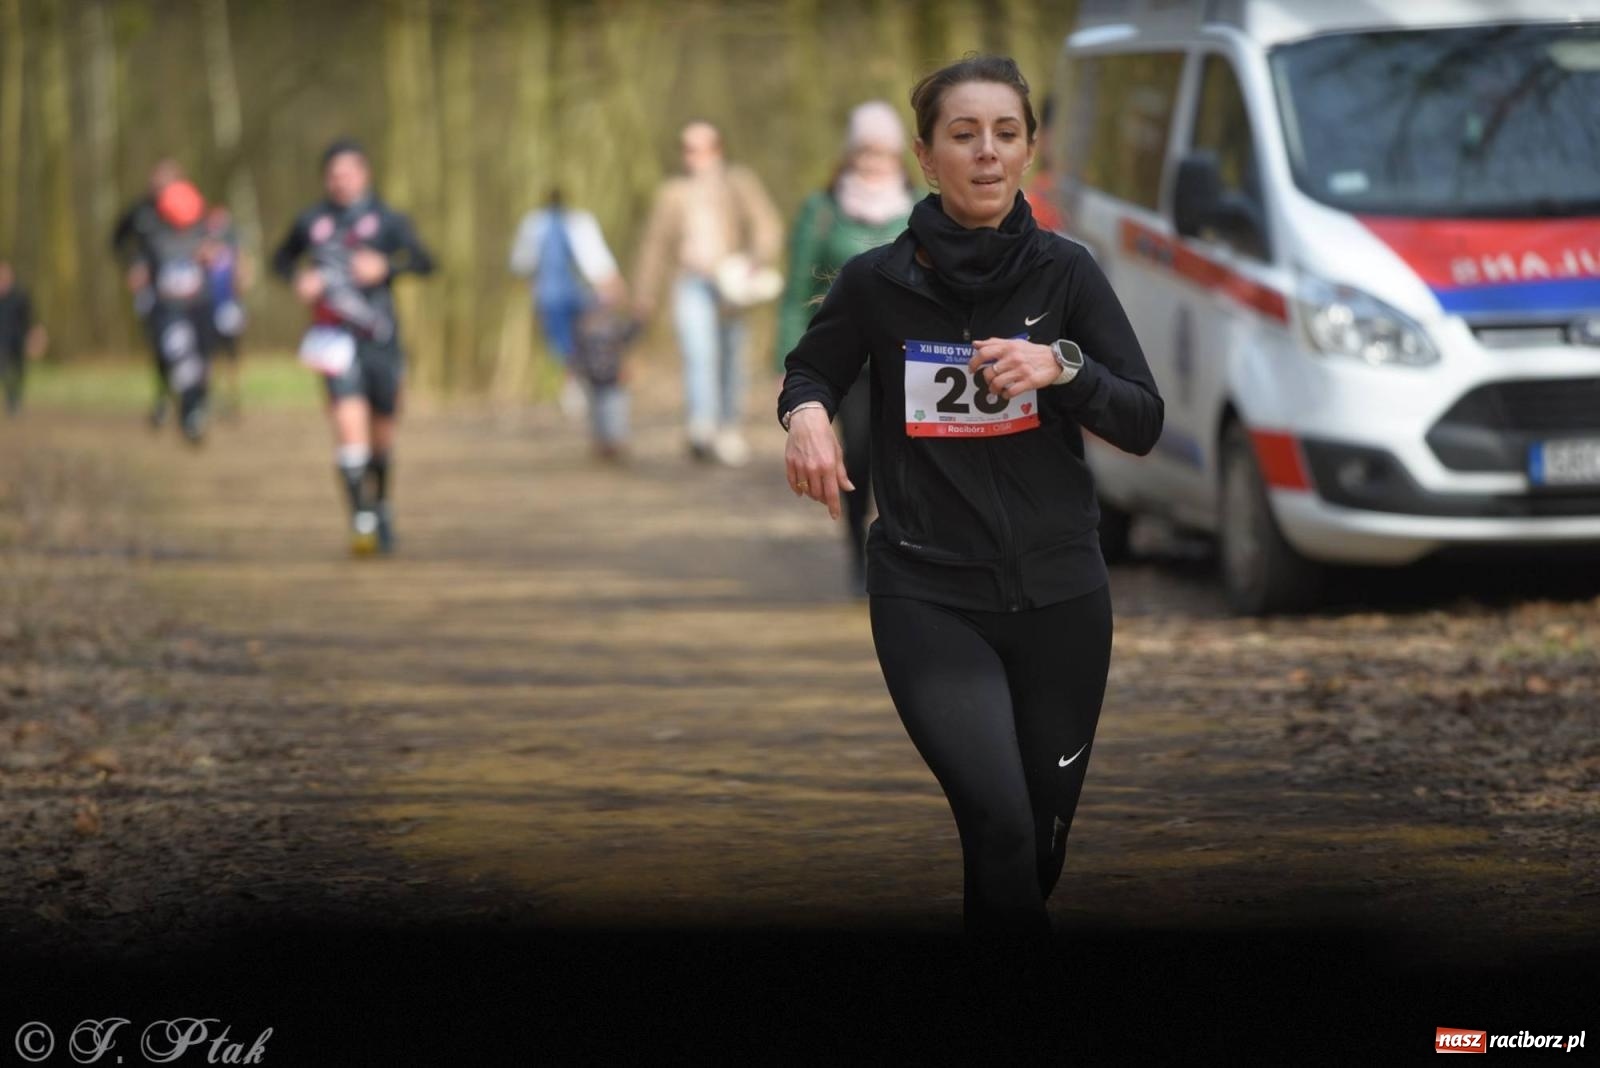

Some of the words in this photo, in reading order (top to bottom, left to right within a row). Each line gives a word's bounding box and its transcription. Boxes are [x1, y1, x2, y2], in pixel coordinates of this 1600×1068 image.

[920, 344, 932, 353] XII
[933, 345, 954, 356] BIEG
[934, 366, 1010, 414] 28
[948, 424, 985, 433] Racibórz
